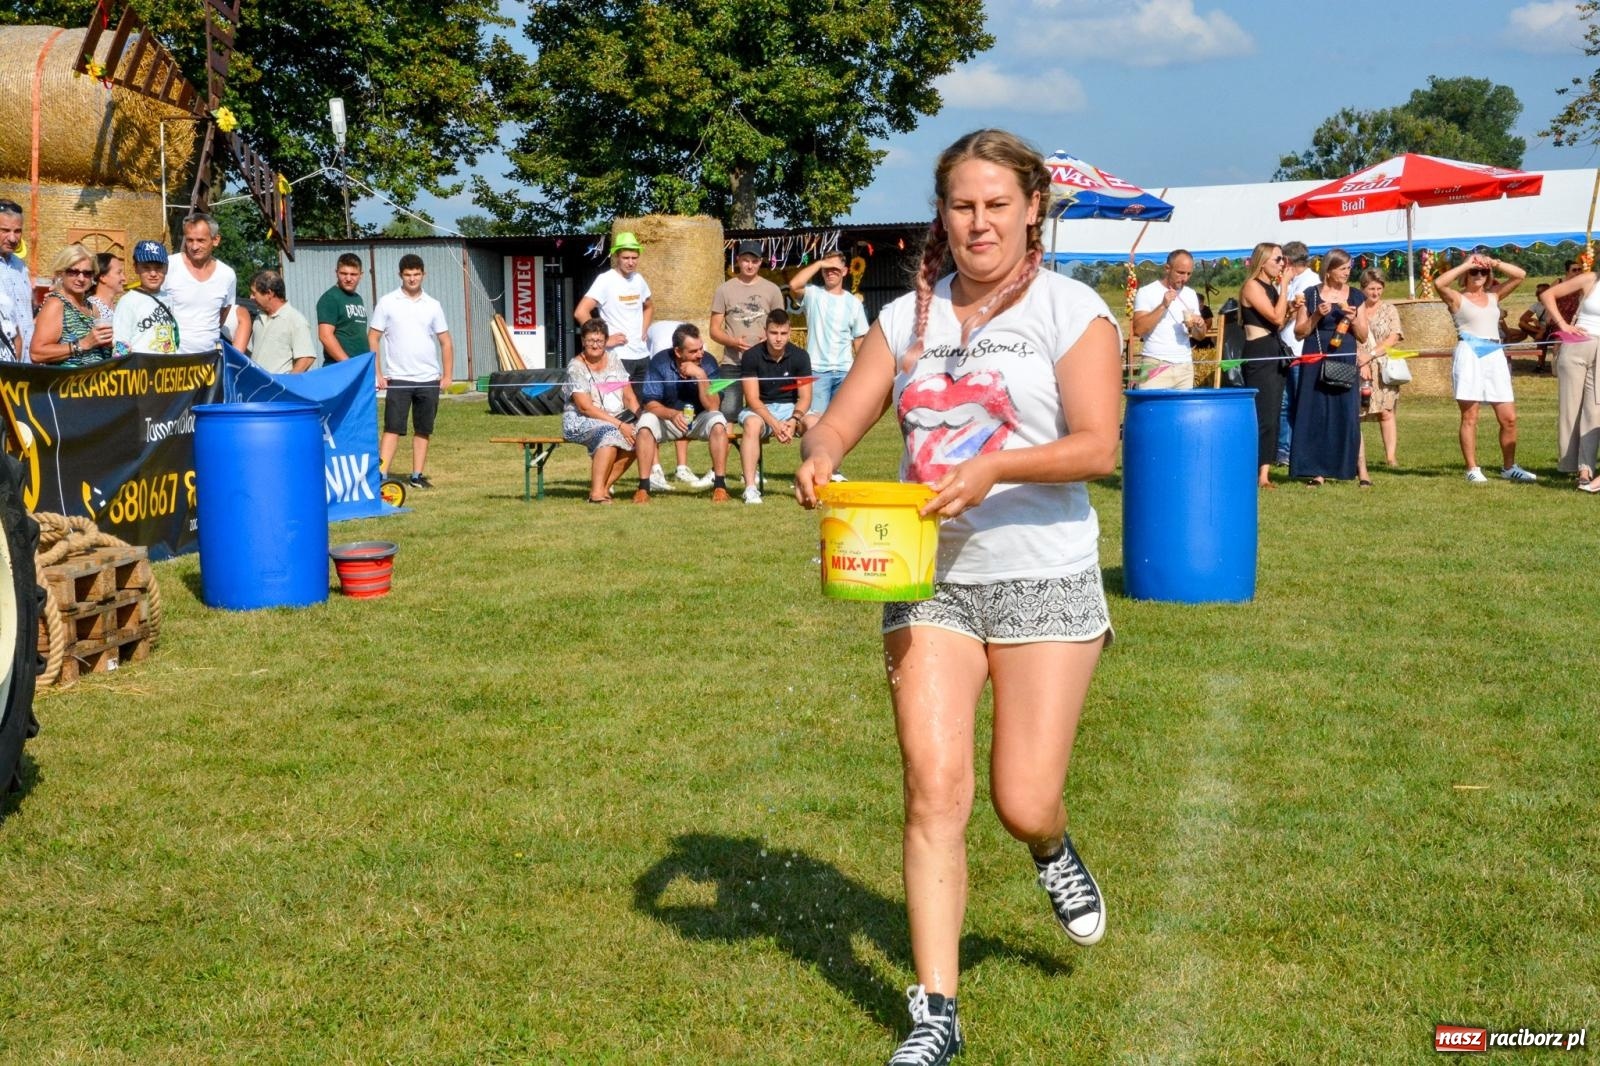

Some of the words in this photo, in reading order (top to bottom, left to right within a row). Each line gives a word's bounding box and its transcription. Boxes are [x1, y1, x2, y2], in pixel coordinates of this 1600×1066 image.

[515, 261, 533, 325] ŻYWIEC
[971, 339, 1035, 358] Stones
[831, 555, 889, 573] MIX-VIT
